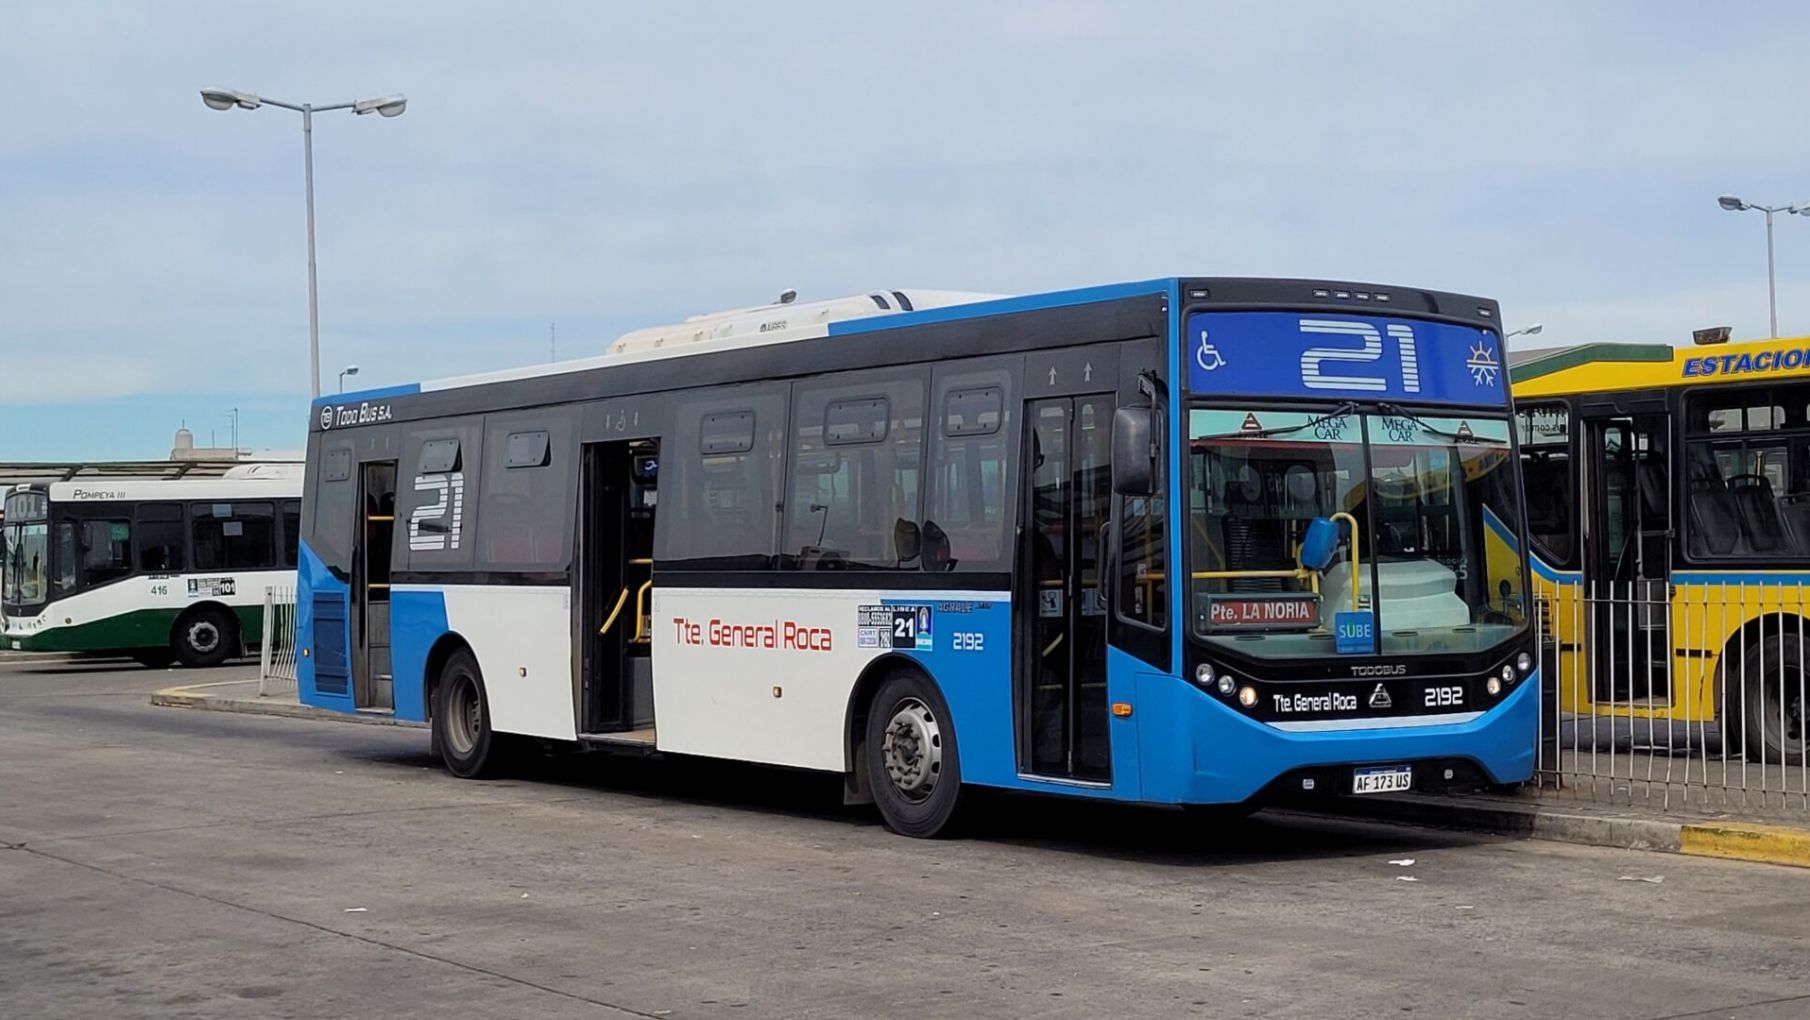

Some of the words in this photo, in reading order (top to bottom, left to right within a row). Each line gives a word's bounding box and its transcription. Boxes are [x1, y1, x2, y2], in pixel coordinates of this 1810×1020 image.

[1299, 319, 1420, 393] 21
[1682, 347, 1810, 378] ESTACIO
[1307, 414, 1347, 429] MEGA
[1381, 416, 1419, 431] MEGA
[1314, 427, 1342, 440] CAR
[1388, 429, 1414, 442] CAR
[117, 491, 126, 499] III
[10, 495, 37, 519] 101
[409, 471, 464, 551] 21
[150, 585, 168, 595] 416
[220, 582, 235, 593] 101
[937, 602, 973, 613] AGRALE
[1211, 603, 1237, 620] Pte.
[1242, 603, 1260, 619] LA
[1265, 602, 1309, 619] NORIA
[673, 618, 704, 645] Tte.
[709, 619, 778, 649] General
[784, 621, 832, 651] Roca
[894, 617, 914, 638] 21
[1339, 624, 1371, 638] SUBE
[953, 632, 984, 650] 2192
[1351, 665, 1406, 676] TODOBUS
[1273, 694, 1292, 712] Tte.
[1294, 691, 1332, 712] General
[1333, 692, 1357, 710] Roca
[1424, 686, 1463, 707] 2192
[1356, 776, 1370, 791] AF
[1373, 775, 1393, 790] 173
[1396, 773, 1409, 788] US
